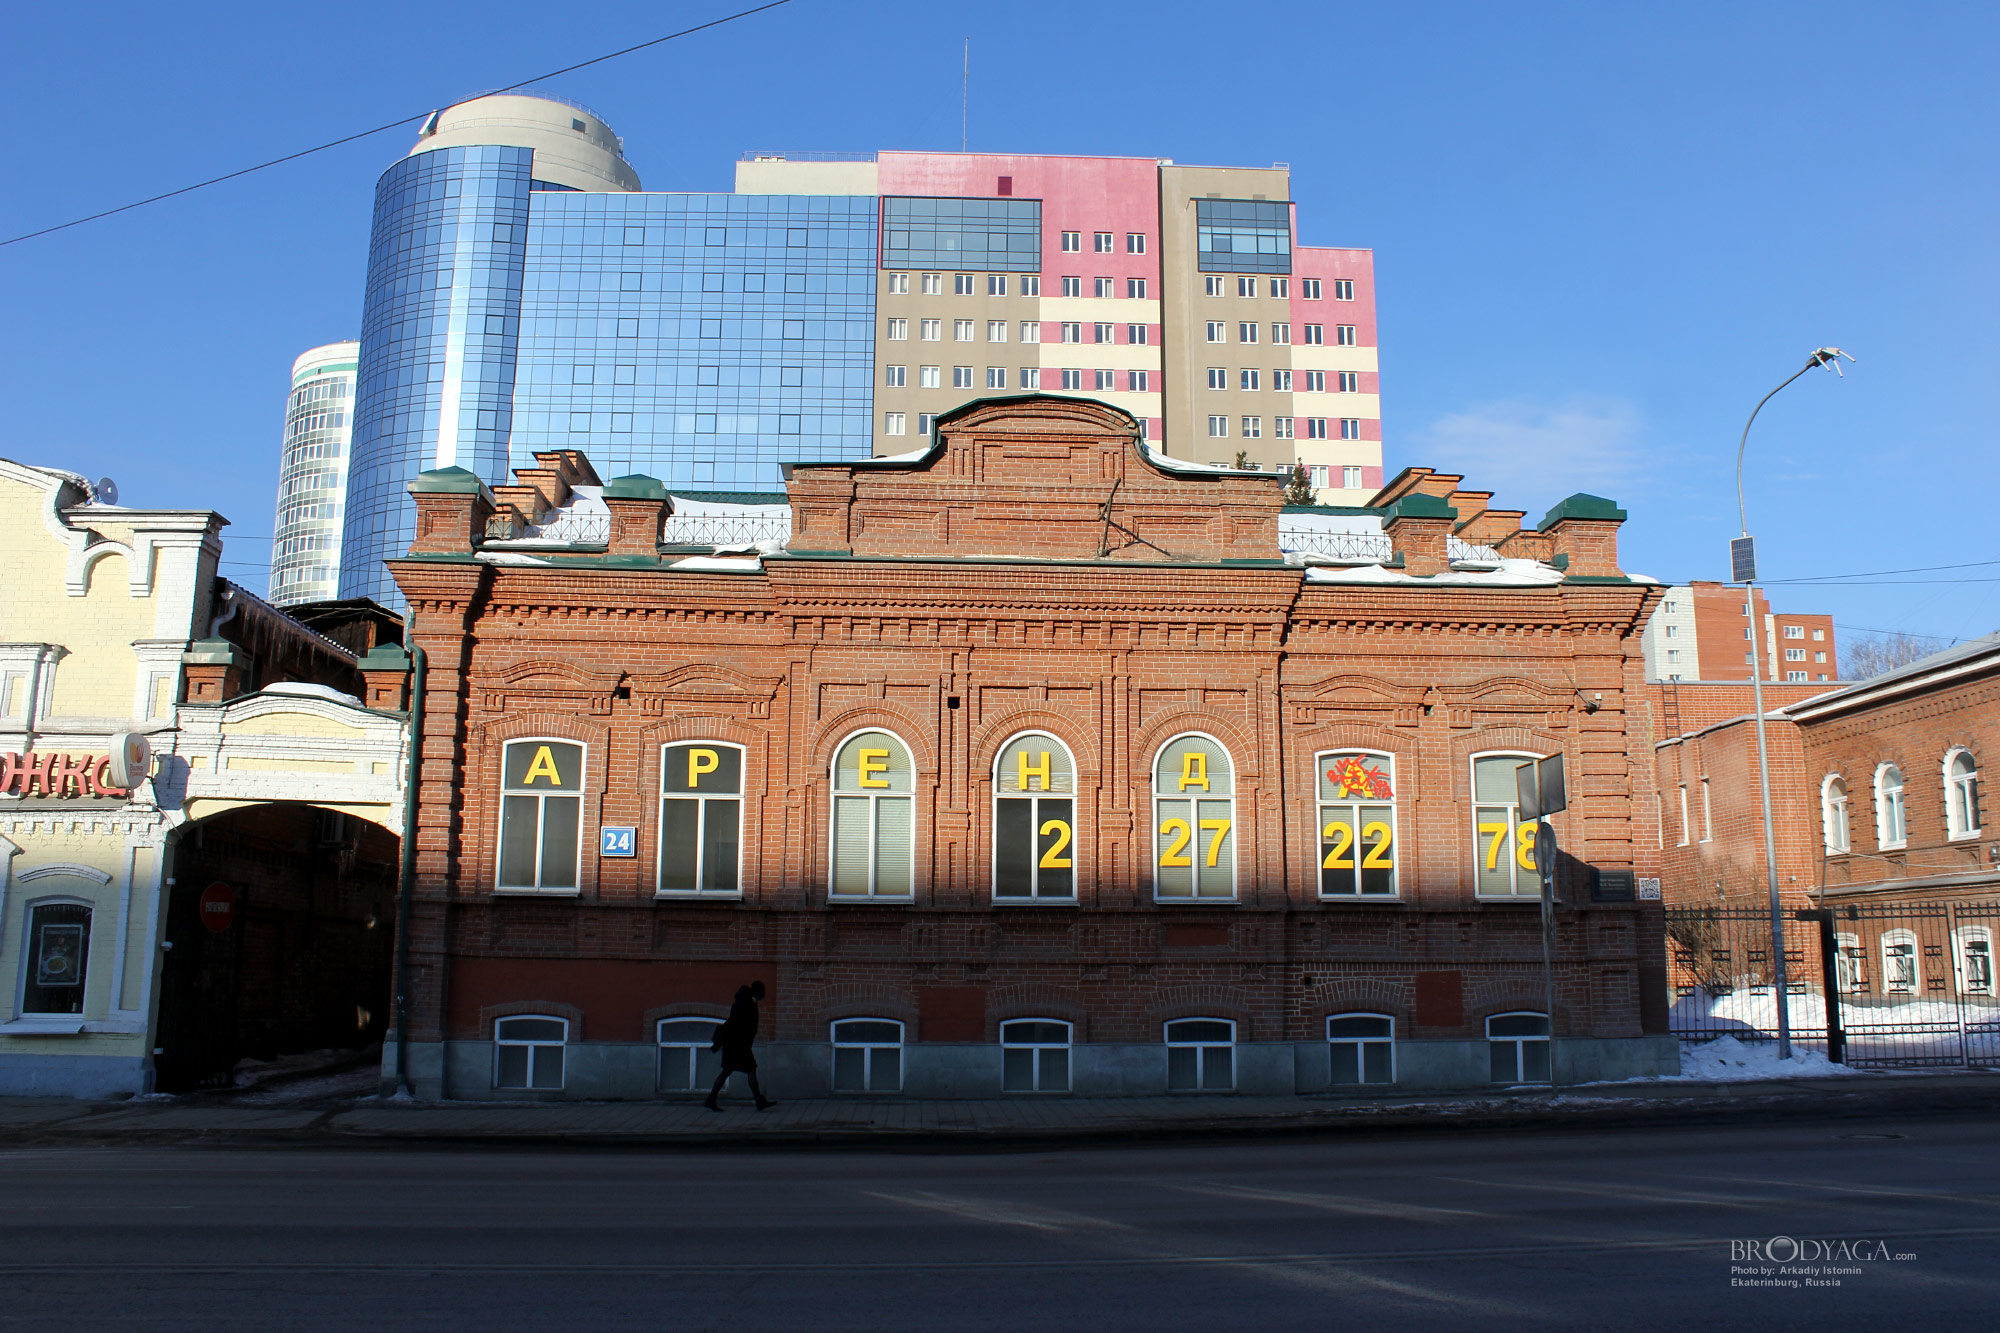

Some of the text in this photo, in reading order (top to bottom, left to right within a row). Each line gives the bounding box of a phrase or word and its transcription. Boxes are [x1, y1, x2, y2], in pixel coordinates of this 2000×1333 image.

[605, 832, 630, 851] 24
[1039, 820, 1073, 869] 2
[1159, 818, 1231, 867] 27
[1322, 821, 1393, 869] 22
